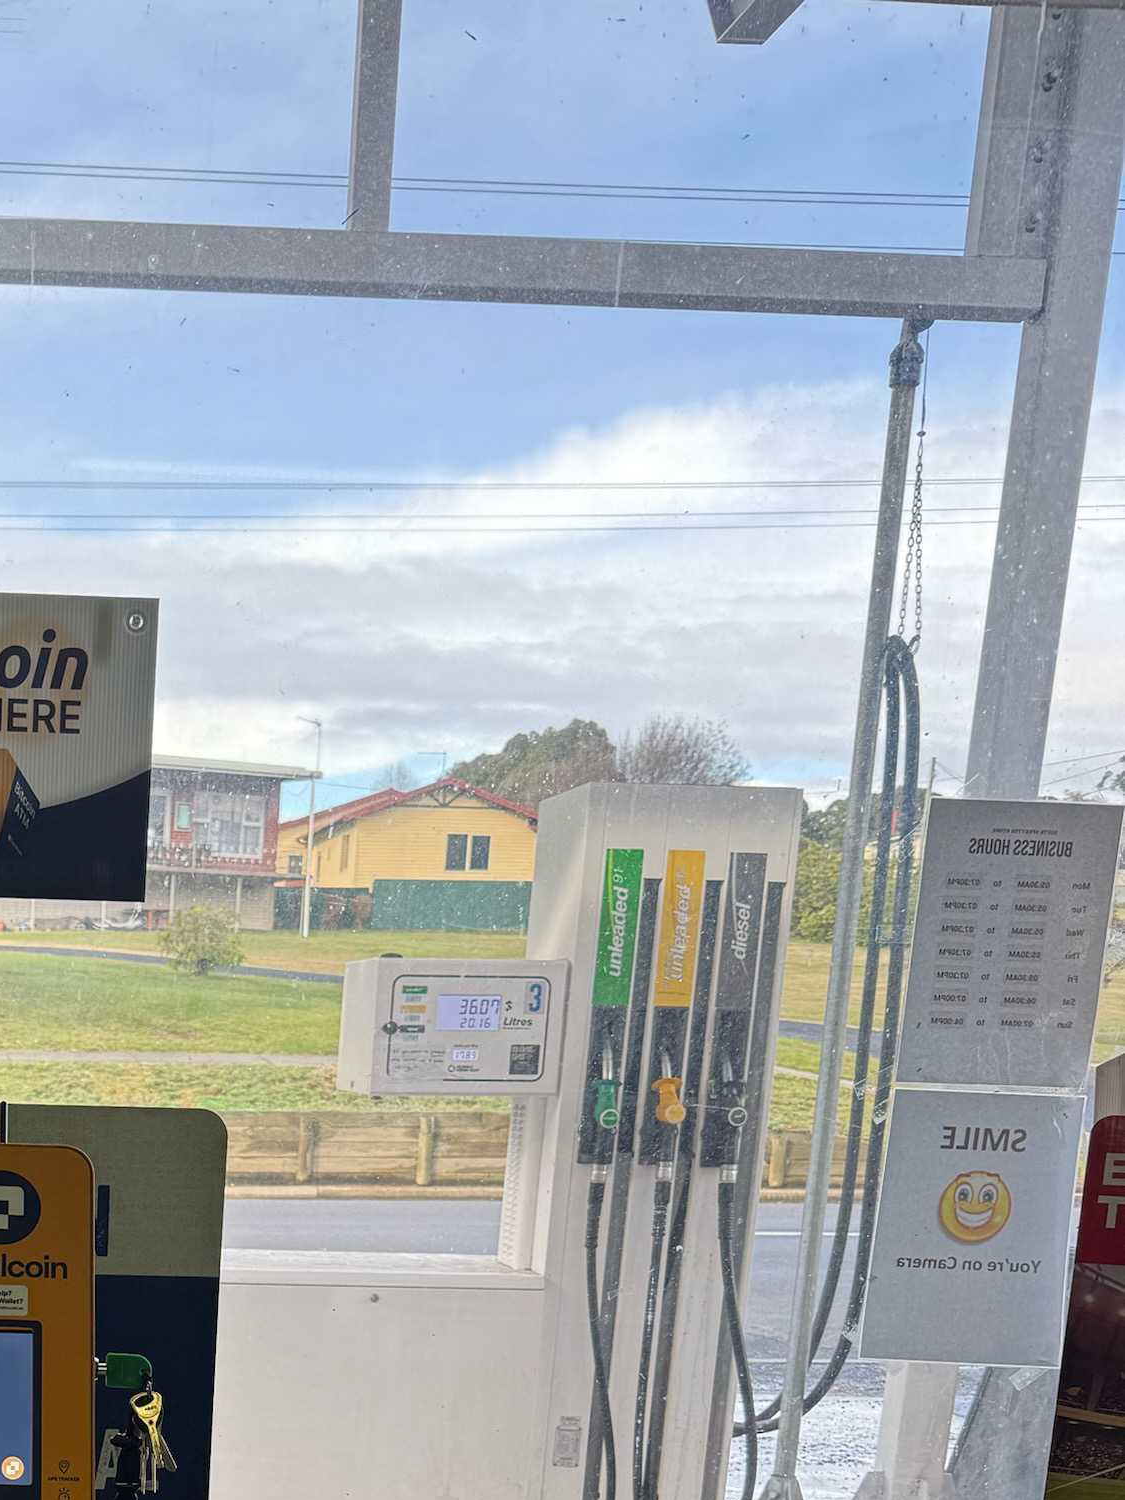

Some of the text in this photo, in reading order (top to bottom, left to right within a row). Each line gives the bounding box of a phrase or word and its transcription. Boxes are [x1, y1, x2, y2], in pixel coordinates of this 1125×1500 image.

[608, 887, 629, 978] unleaded
[730, 901, 750, 959] diesel
[529, 983, 542, 1012] 3
[503, 1017, 533, 1027] Litres
